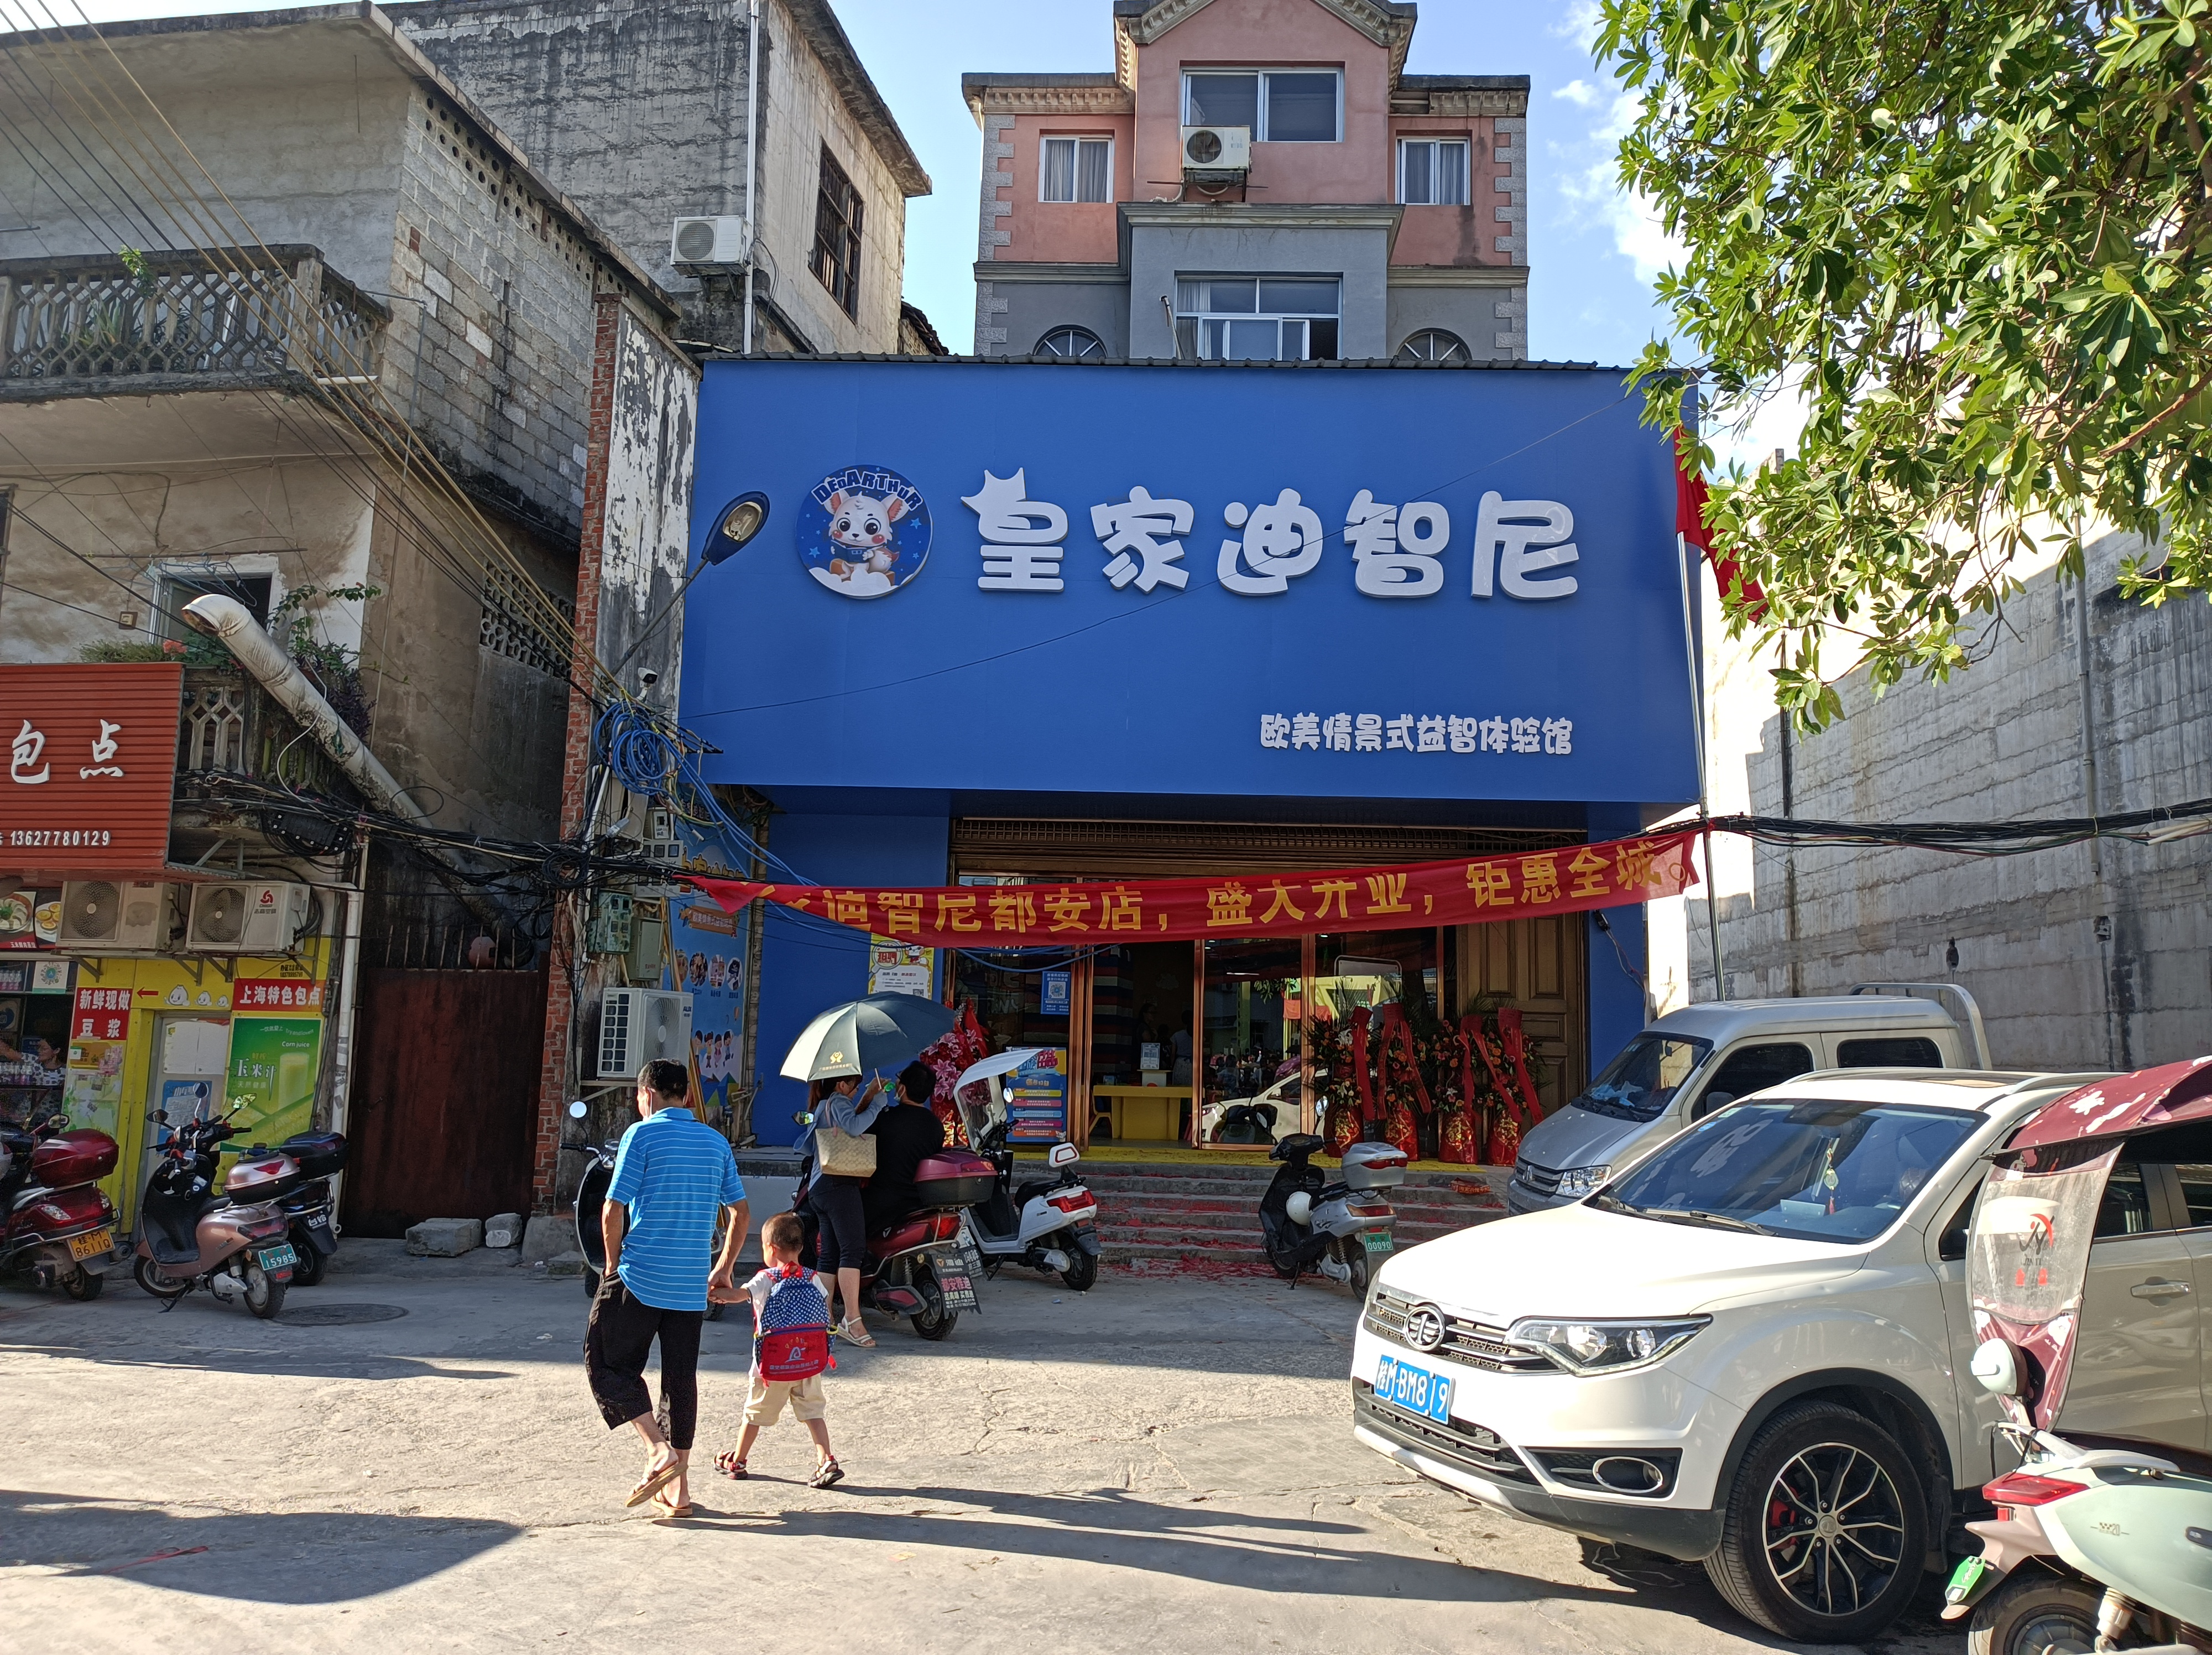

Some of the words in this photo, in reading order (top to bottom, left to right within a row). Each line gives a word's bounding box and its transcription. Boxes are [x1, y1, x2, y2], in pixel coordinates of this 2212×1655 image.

[961, 466, 1579, 600] 皇家迪智尼
[1260, 712, 1572, 754] 欧美情景式益智体验馆
[11, 719, 124, 784] 包点
[11, 830, 111, 846] 13627780129
[80, 989, 131, 1010] 新鲜现做
[239, 985, 321, 1006] 上海特色包点
[80, 1018, 121, 1038] 豆浆
[234, 1058, 276, 1100] 玉米汁
[1368, 1242, 1391, 1250] 00090
[265, 1253, 294, 1268] 15985
